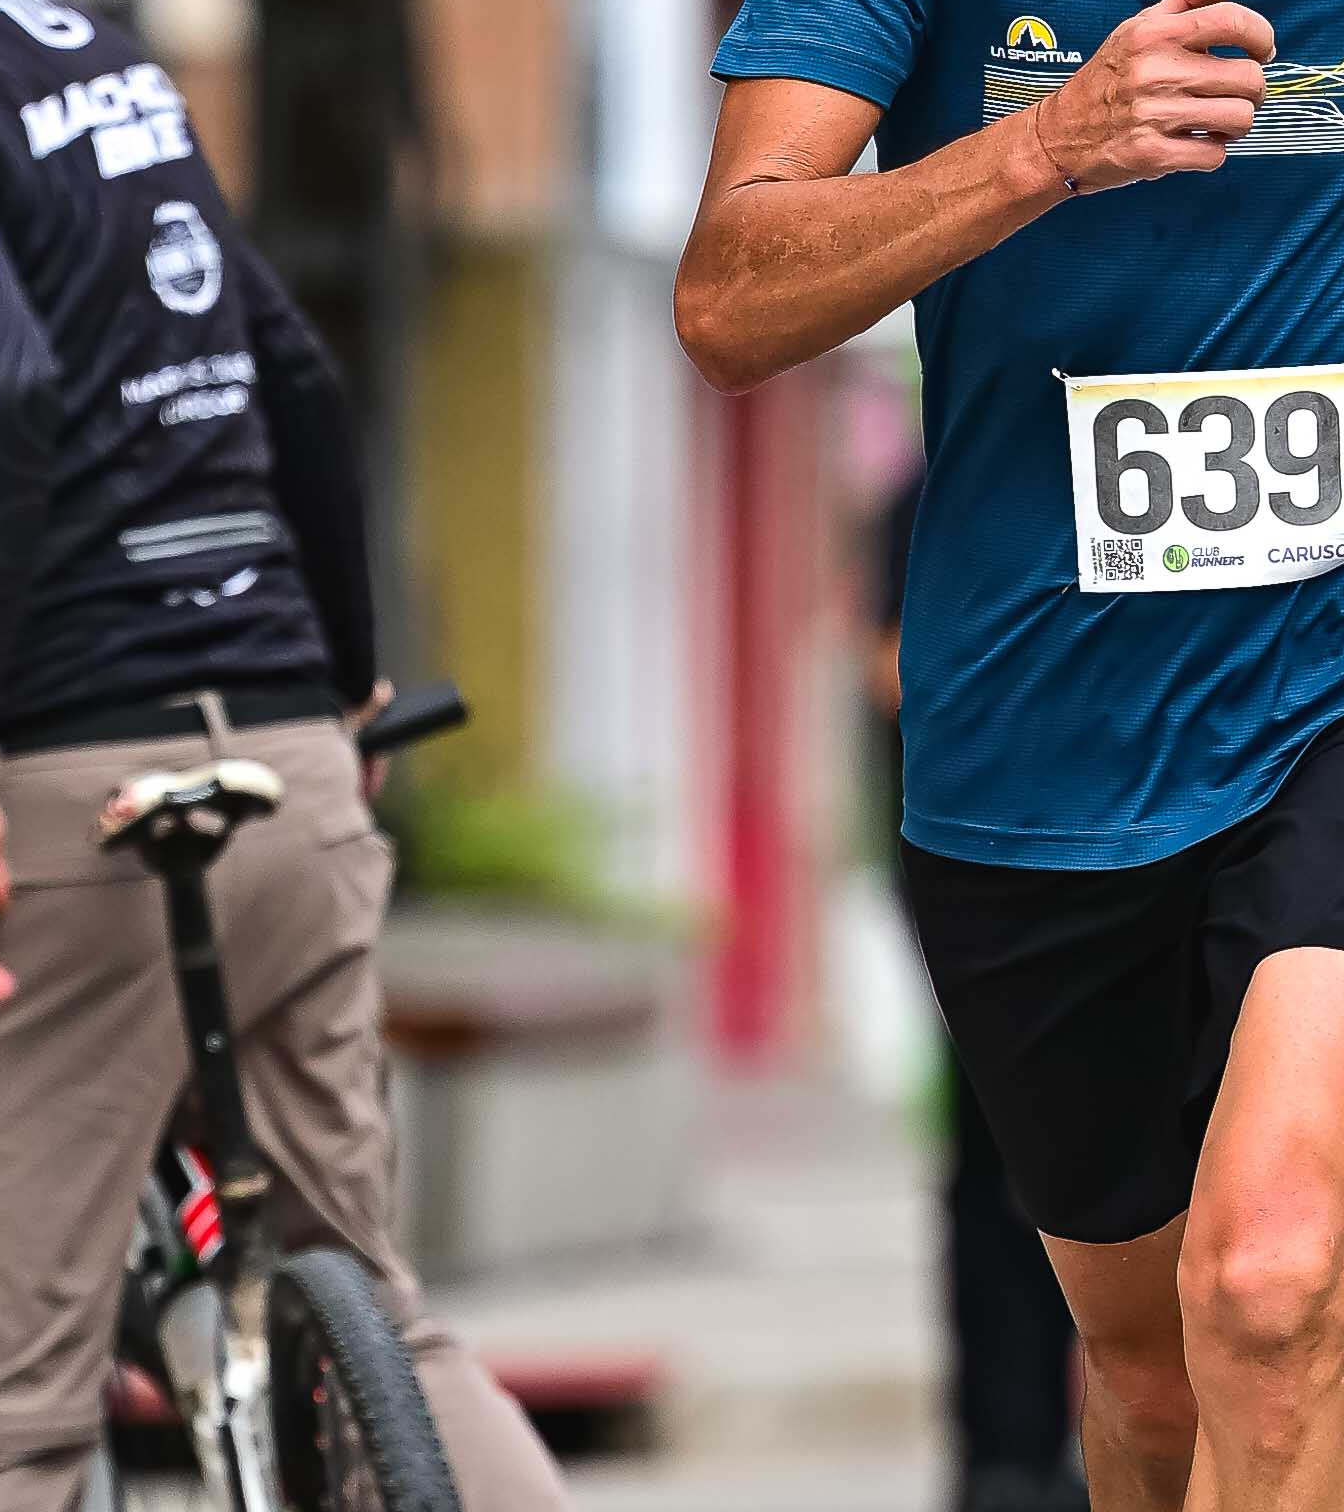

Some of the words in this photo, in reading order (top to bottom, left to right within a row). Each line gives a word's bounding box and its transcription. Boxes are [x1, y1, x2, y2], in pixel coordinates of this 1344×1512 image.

[990, 45, 1006, 59] LA
[1007, 48, 1083, 63] SPORTIVA
[1093, 391, 1342, 535] 639
[1192, 546, 1220, 557] CLUB
[1191, 555, 1245, 568] RUNNER'S
